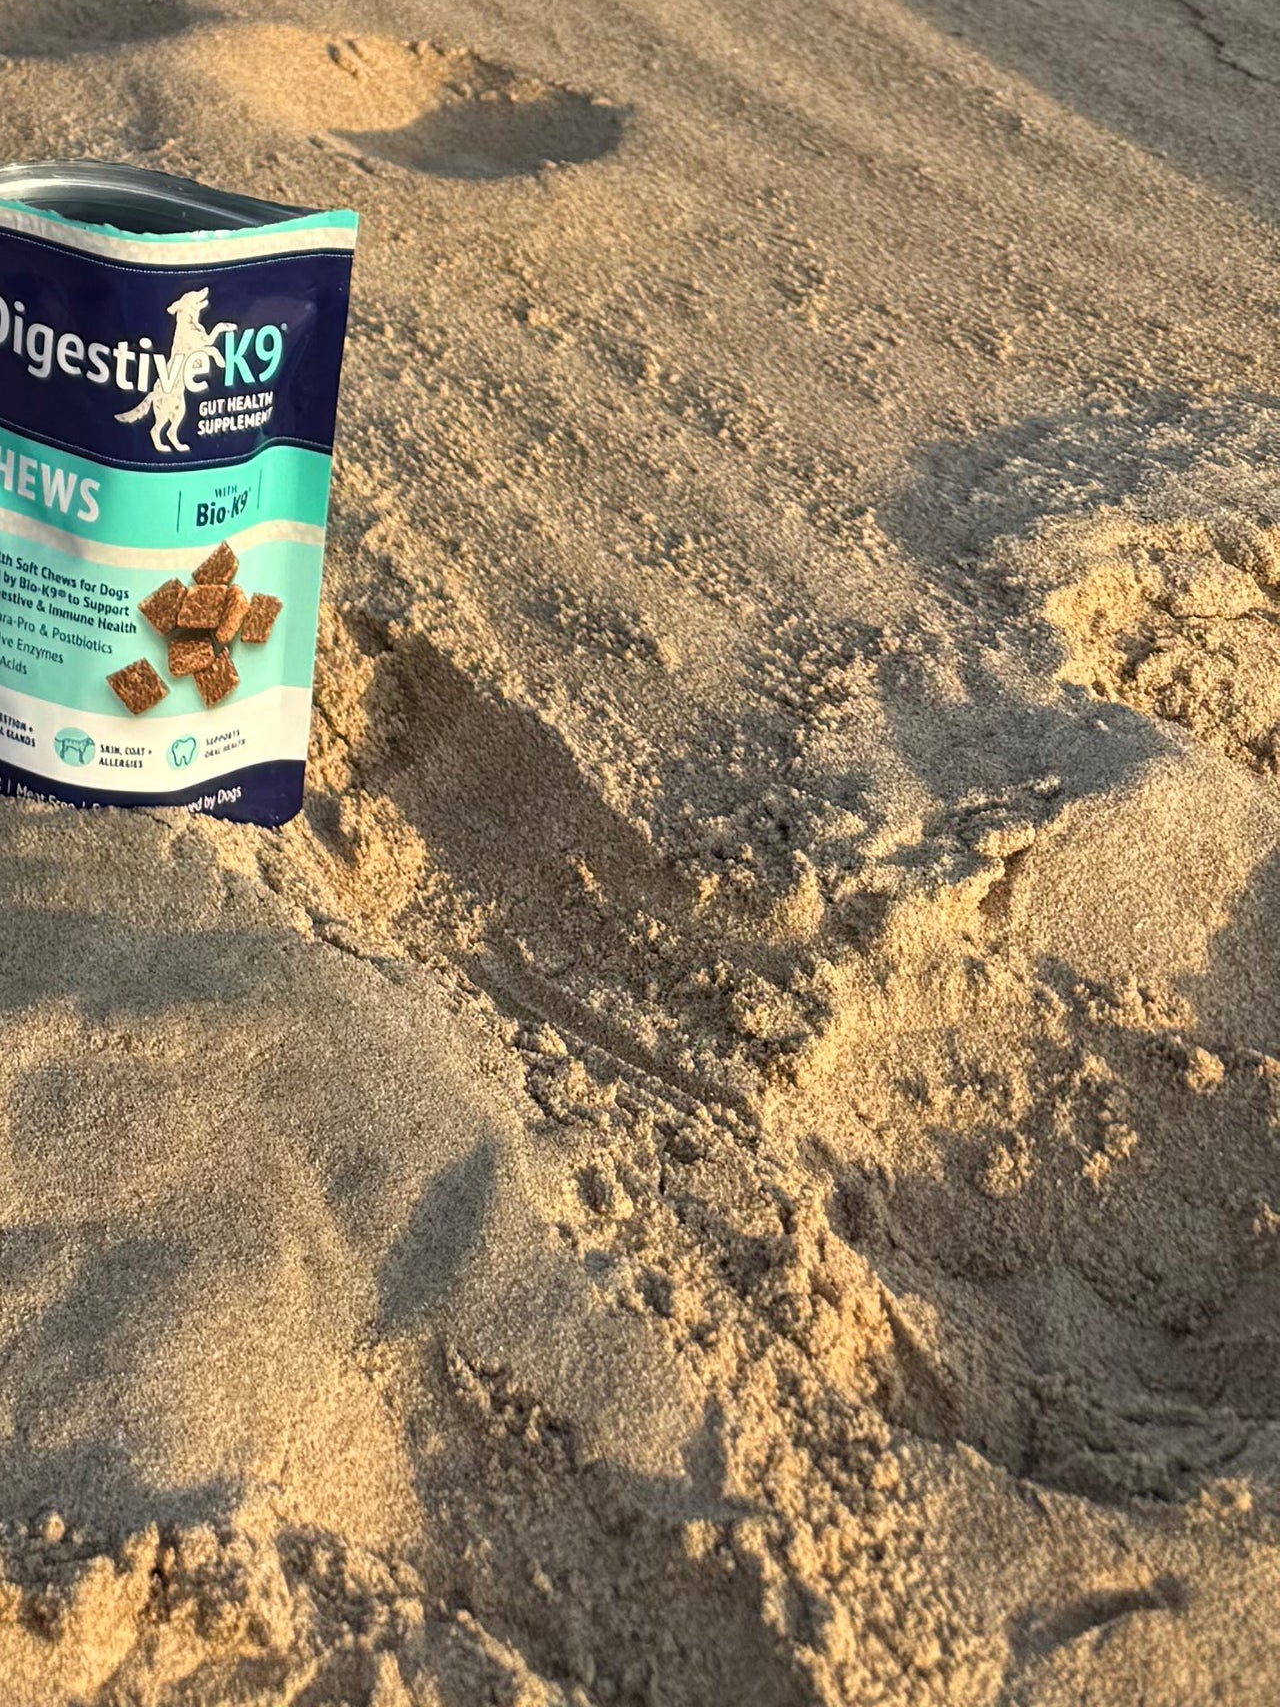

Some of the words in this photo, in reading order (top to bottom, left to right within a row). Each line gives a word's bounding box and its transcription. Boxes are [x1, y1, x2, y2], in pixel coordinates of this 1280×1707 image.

[224, 324, 283, 387] K9
[199, 398, 226, 417] GUT
[227, 390, 274, 412] HEALTH
[197, 406, 274, 436] SUPPLEMENT
[214, 484, 238, 499] WITH
[16, 556, 38, 576] Soft
[41, 566, 77, 588] Chews
[80, 578, 97, 593] for
[100, 583, 129, 601] Dogs
[4, 570, 17, 588] by
[68, 592, 80, 606] to
[83, 596, 129, 616] Support
[36, 599, 46, 613] &
[48, 603, 94, 626] Immune
[98, 617, 137, 634] Health
[16, 638, 64, 664] Enzymes
[39, 623, 48, 637] &
[52, 626, 113, 654] Postbiotics
[0, 655, 28, 675] Acids
[99, 757, 144, 768] ALLERGIES
[217, 786, 242, 805] Dogs
